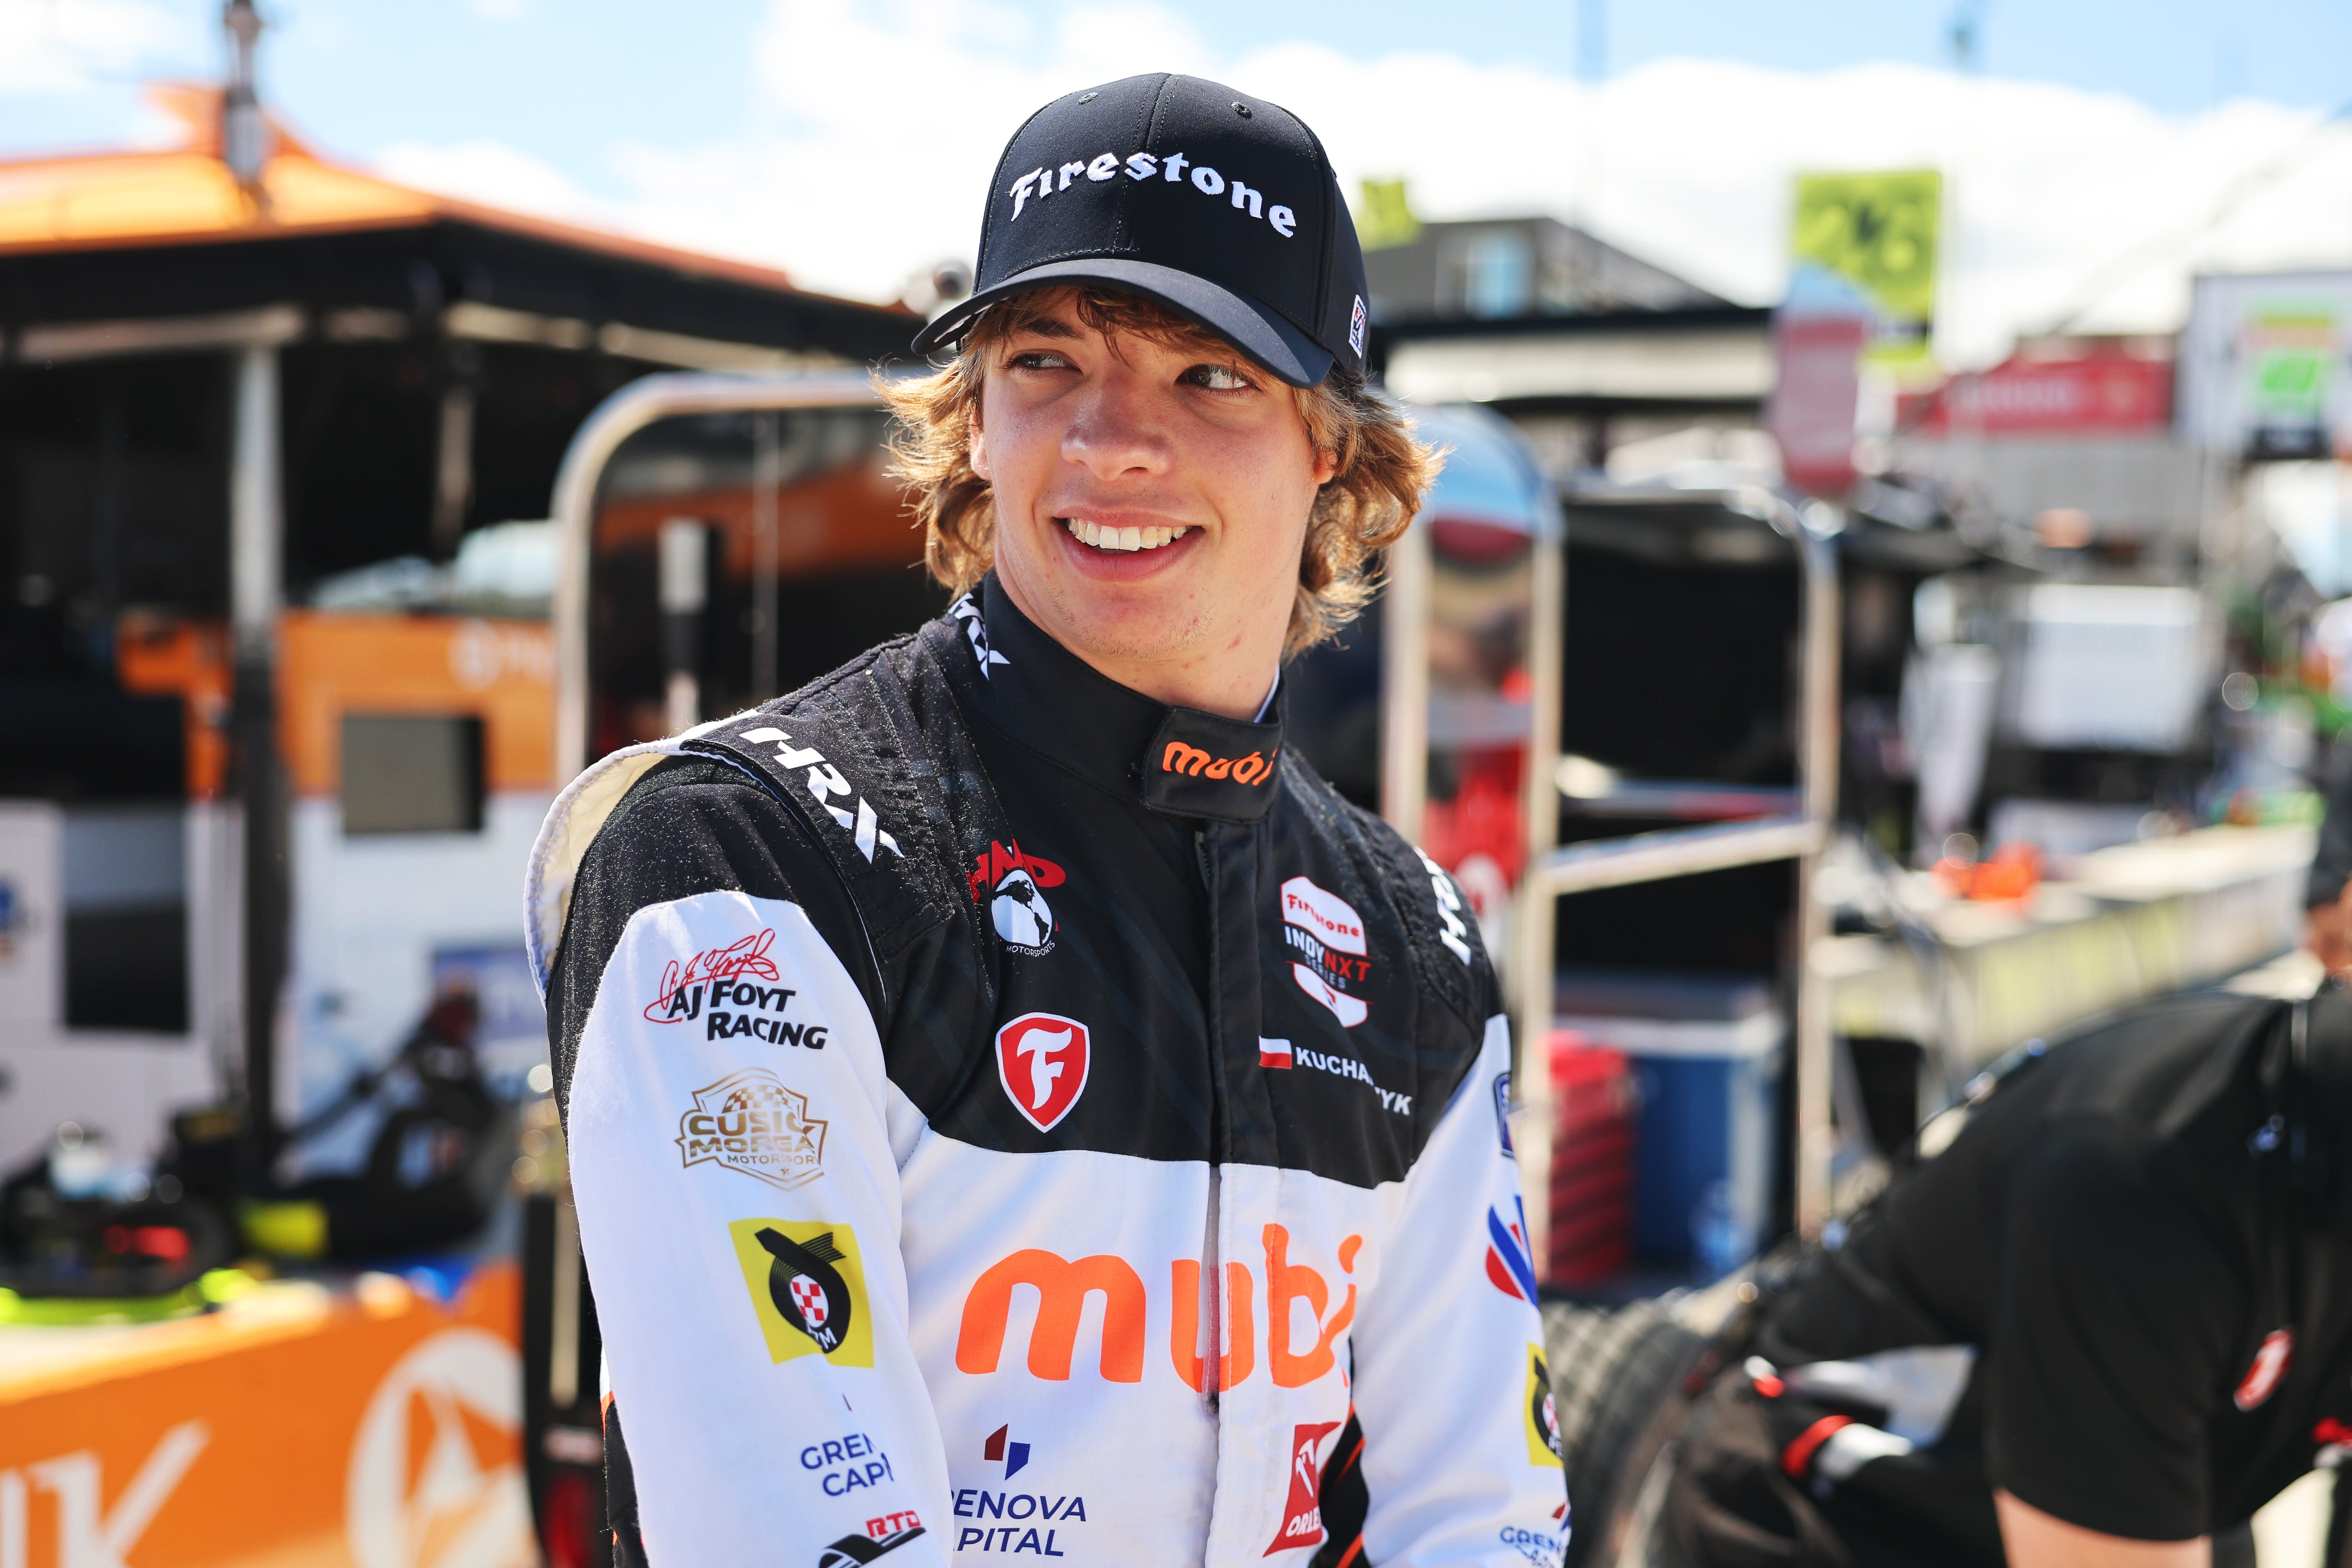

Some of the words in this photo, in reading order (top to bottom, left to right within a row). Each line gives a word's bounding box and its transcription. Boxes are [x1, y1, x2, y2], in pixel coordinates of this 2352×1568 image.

[1009, 152, 1296, 238] Firestone
[739, 727, 905, 865] HRX
[1006, 940, 1056, 958] MOTORSPORTS
[1304, 953, 1346, 990] SERIES
[667, 985, 703, 1021] AJ
[710, 980, 796, 1012] FOYT
[708, 1012, 829, 1049] RACING
[1017, 1026, 1073, 1109] F
[689, 1135, 816, 1158] MORGA
[955, 1223, 1362, 1394] mubi
[951, 1489, 1086, 1522] ENOVA
[953, 1527, 1064, 1557] PITAL
